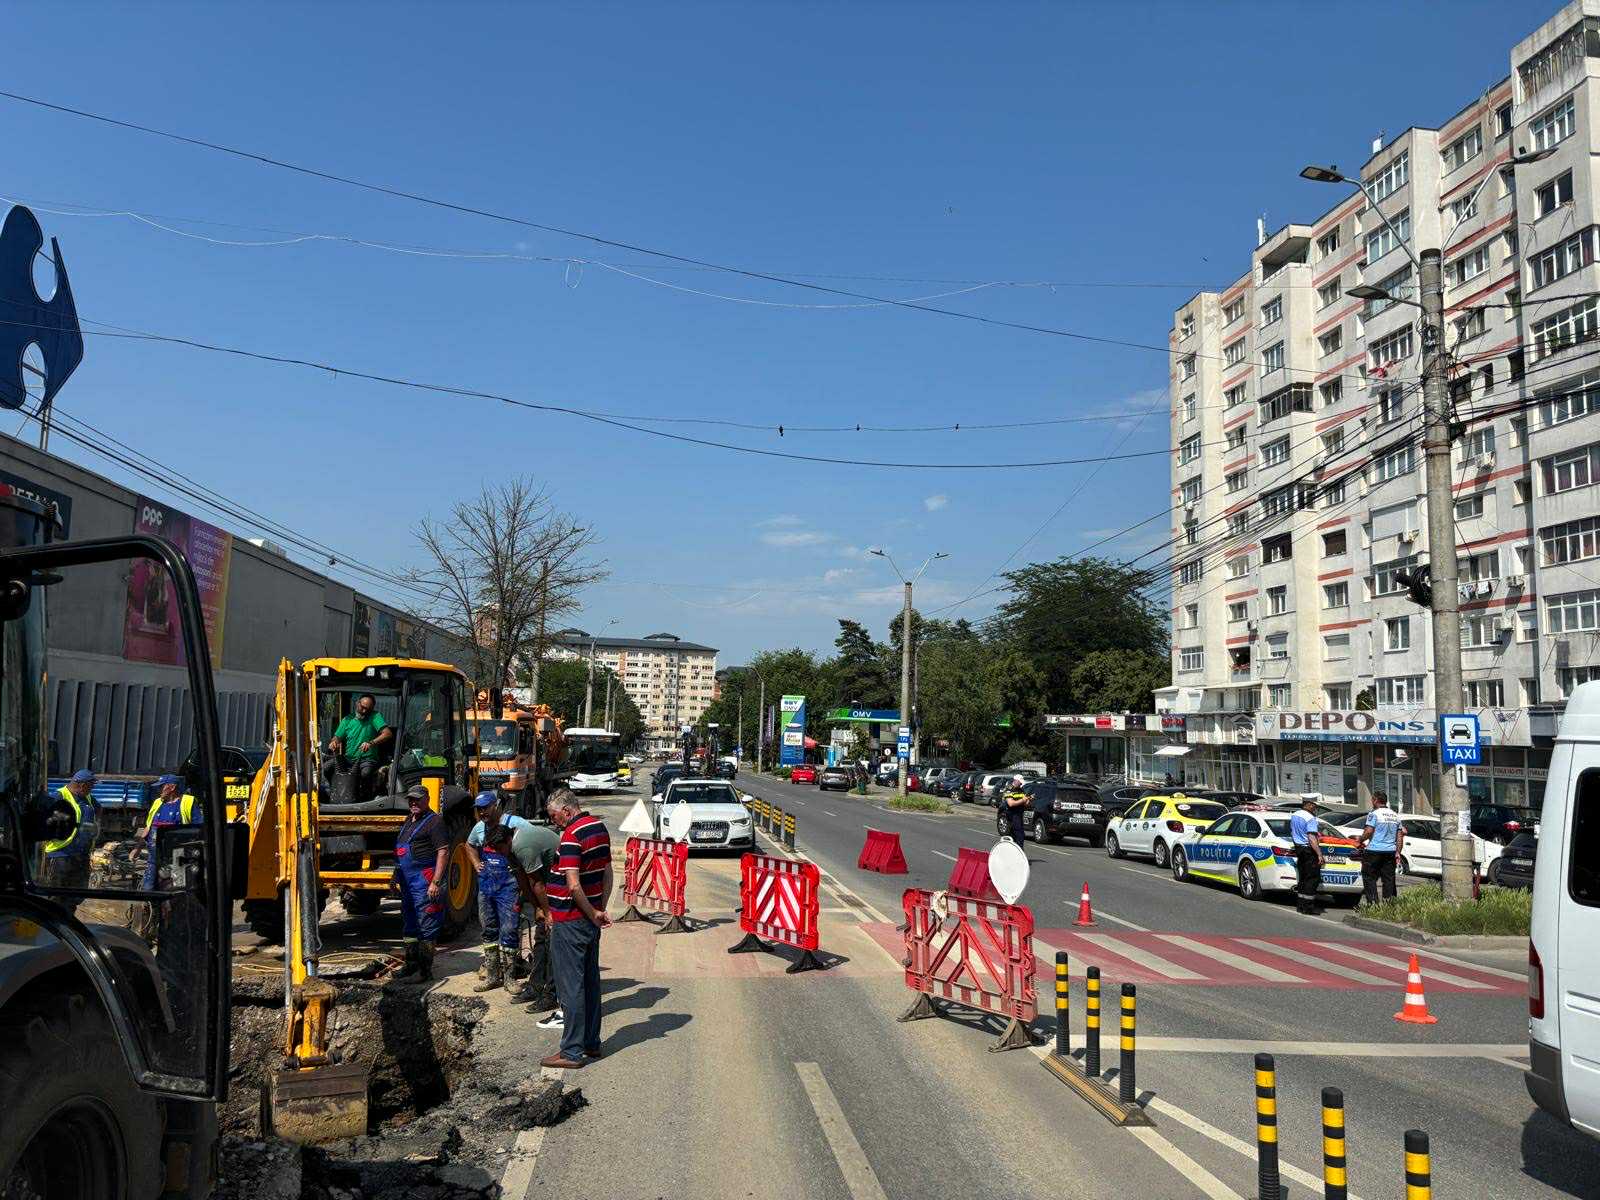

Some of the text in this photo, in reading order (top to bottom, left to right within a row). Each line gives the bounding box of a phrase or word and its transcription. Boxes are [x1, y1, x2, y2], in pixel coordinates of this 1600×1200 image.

[142, 506, 163, 526] ppc
[1279, 712, 1376, 732] DEPO
[1447, 748, 1477, 760] TAXI
